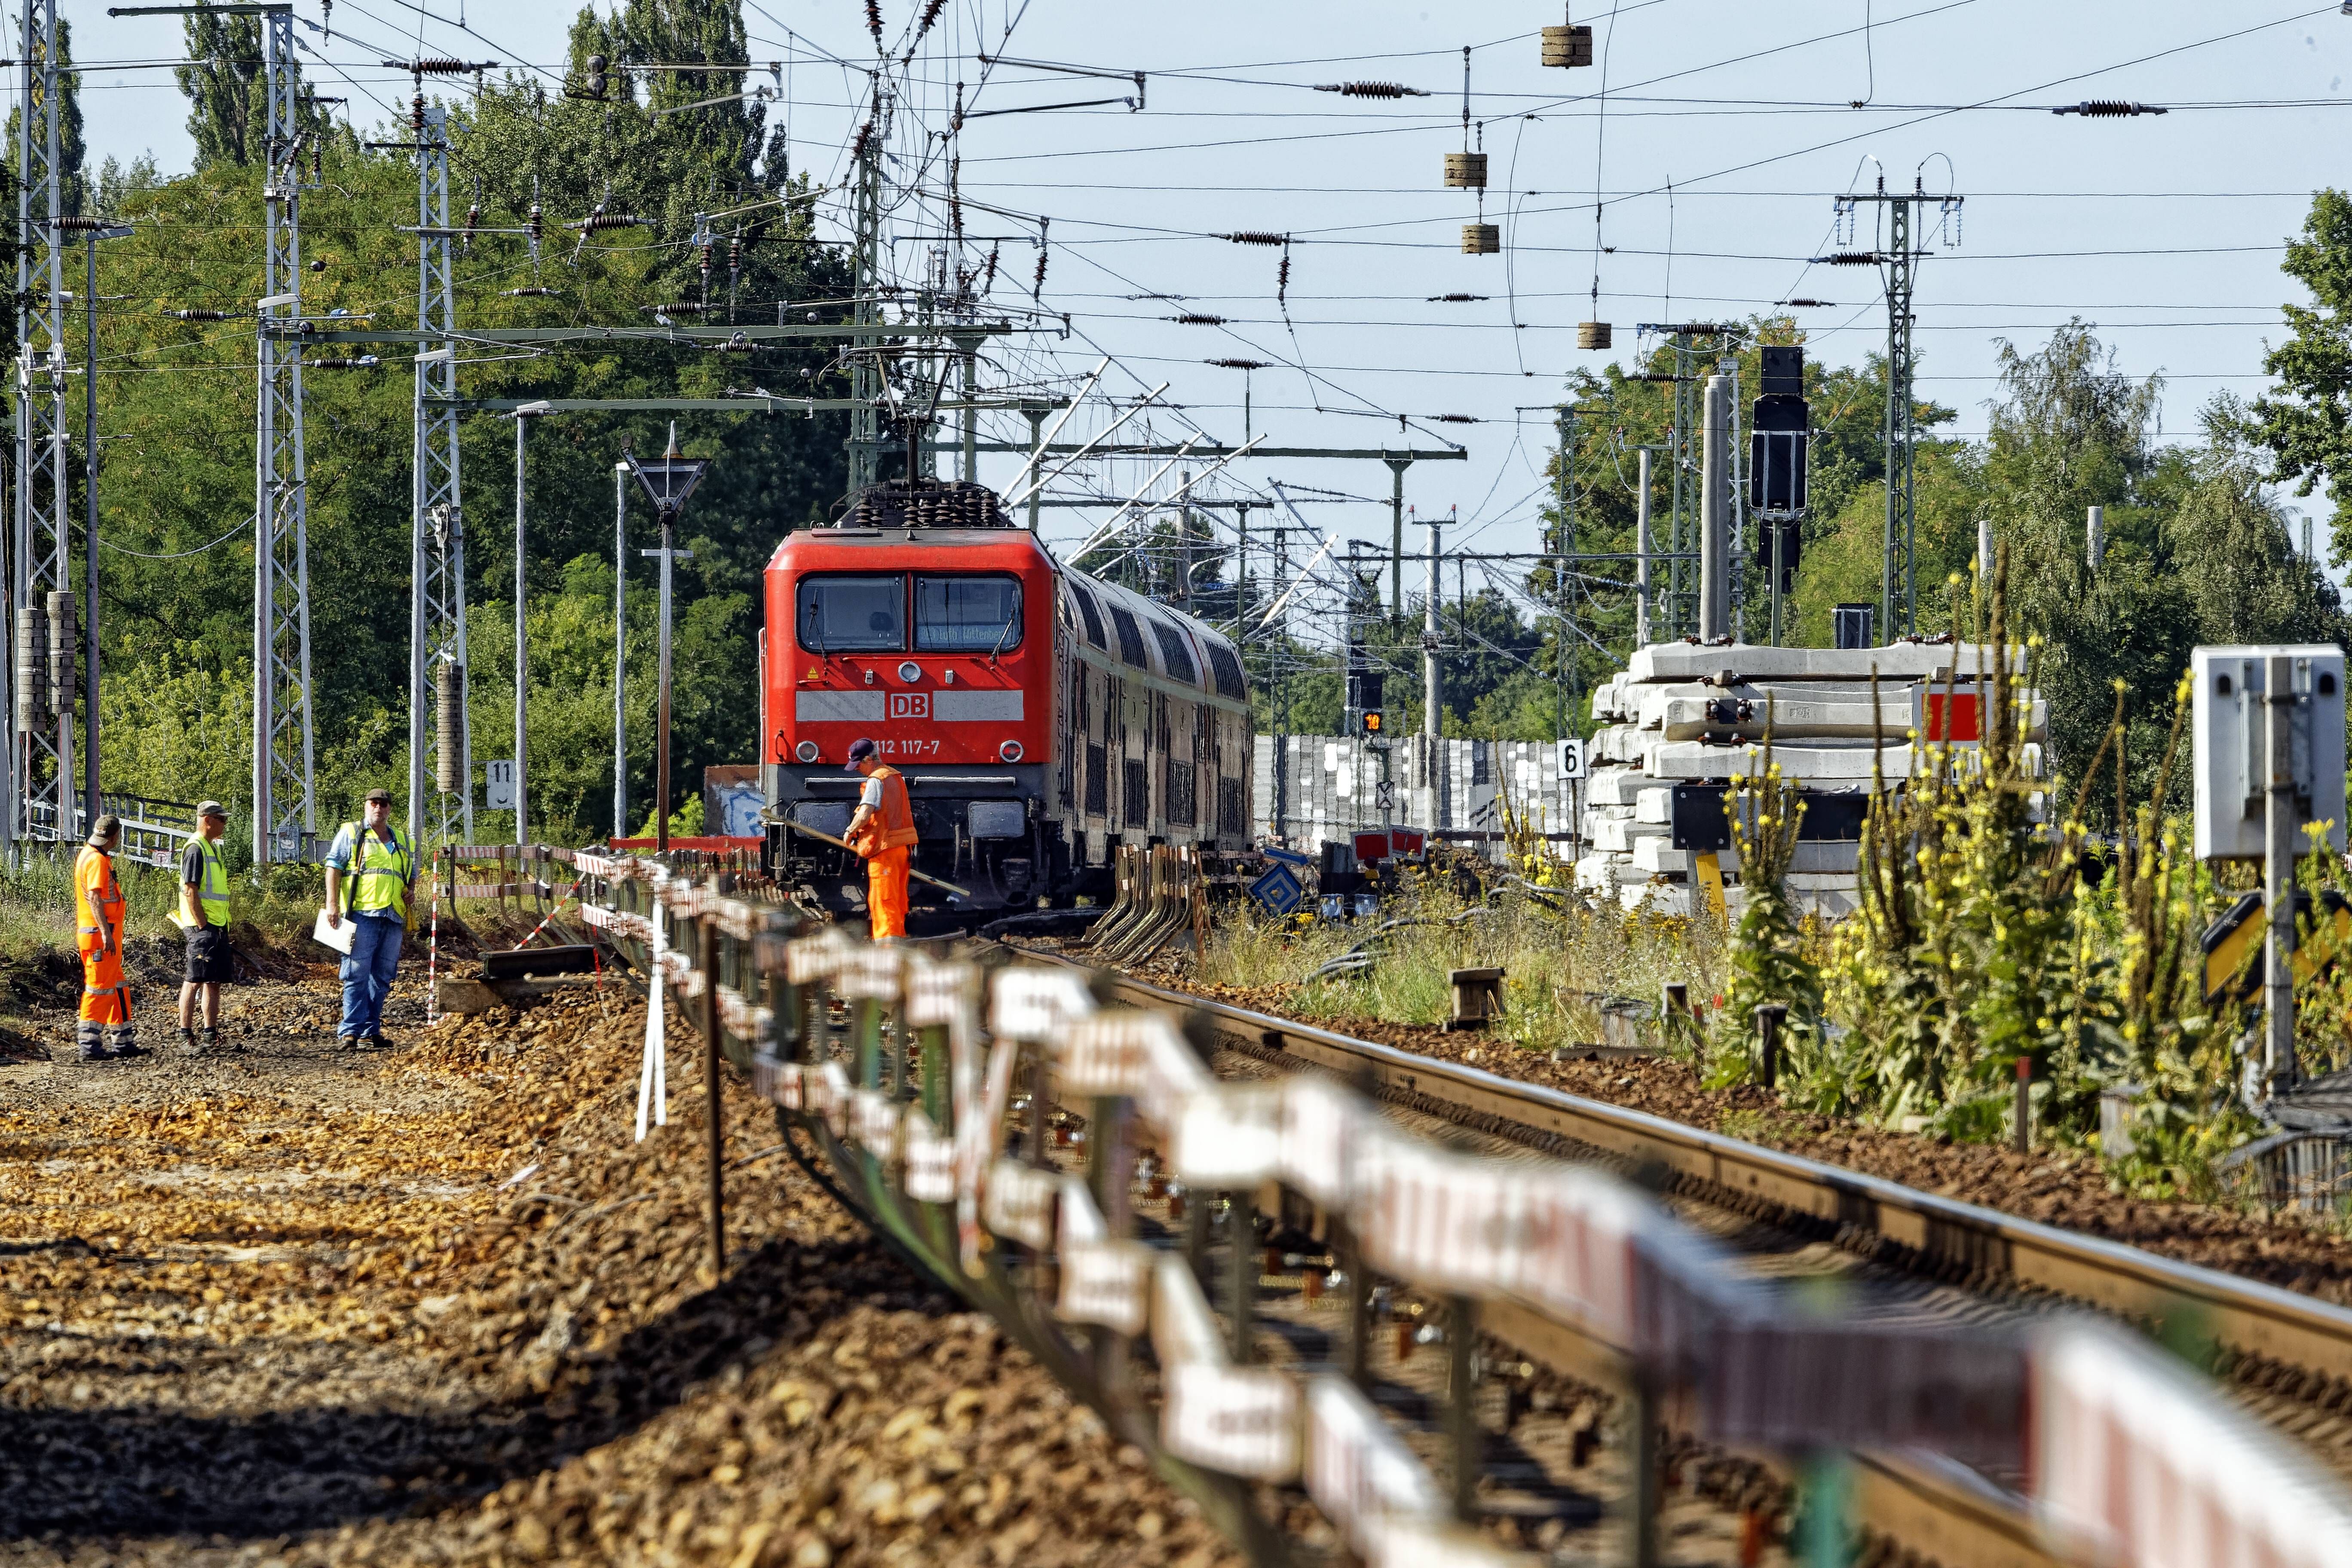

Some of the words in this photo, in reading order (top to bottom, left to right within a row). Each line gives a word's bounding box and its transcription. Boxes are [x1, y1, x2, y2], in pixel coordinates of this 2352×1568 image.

[893, 695, 926, 716] DB
[875, 740, 895, 753] 112
[902, 740, 940, 755] 117-7
[1565, 744, 1577, 773] 6
[493, 762, 510, 784] 11
